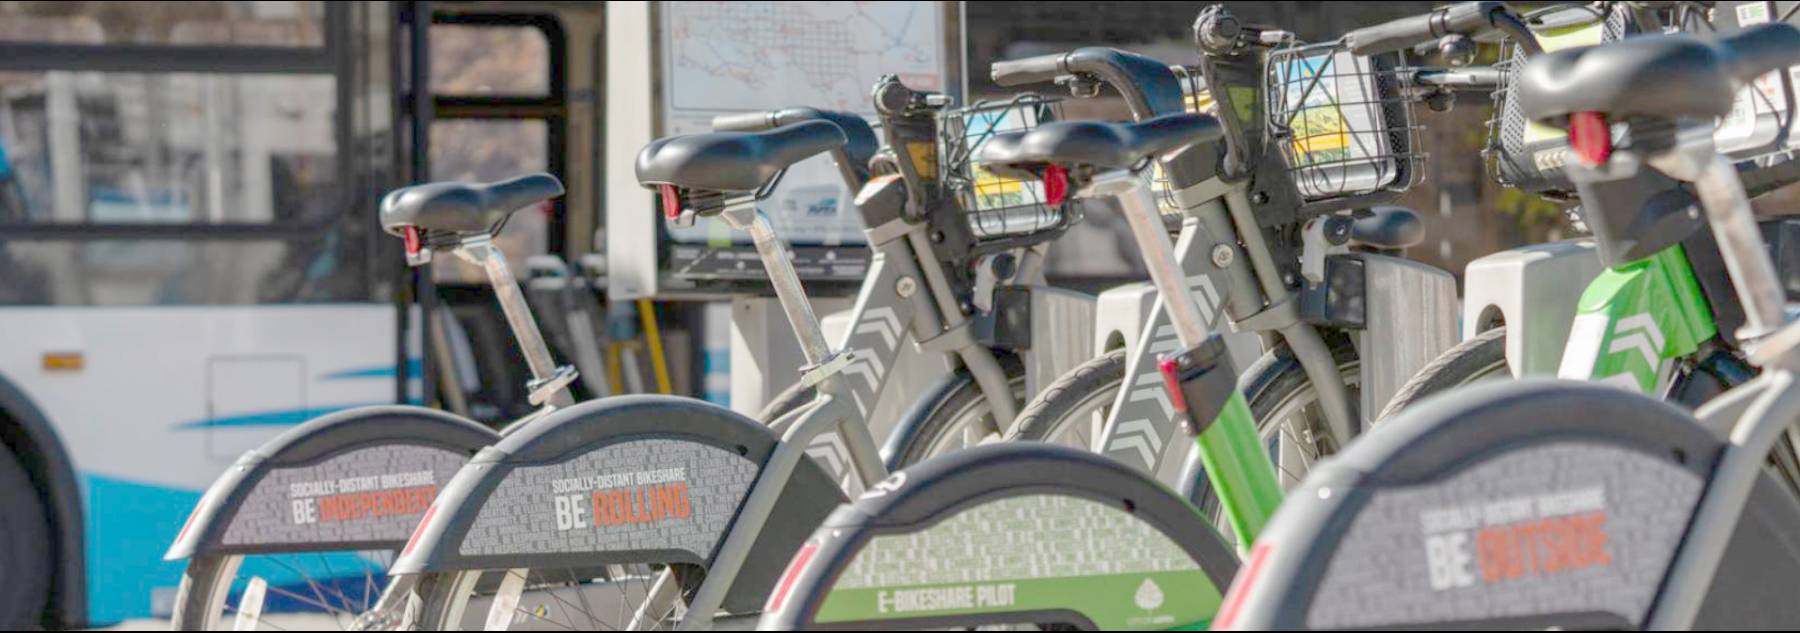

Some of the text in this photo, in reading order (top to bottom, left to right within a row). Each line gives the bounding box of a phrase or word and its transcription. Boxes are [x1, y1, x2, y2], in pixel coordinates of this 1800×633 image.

[381, 470, 434, 489] BIKESHARE
[553, 467, 686, 494] SOCIALLY-DISTANT BIKESHARE
[293, 498, 317, 524] BE
[555, 480, 690, 531] BE ROLLING
[1425, 511, 1613, 591] BE OUTSIDE
[878, 584, 1016, 613] E-BIKESHARE PILOT
